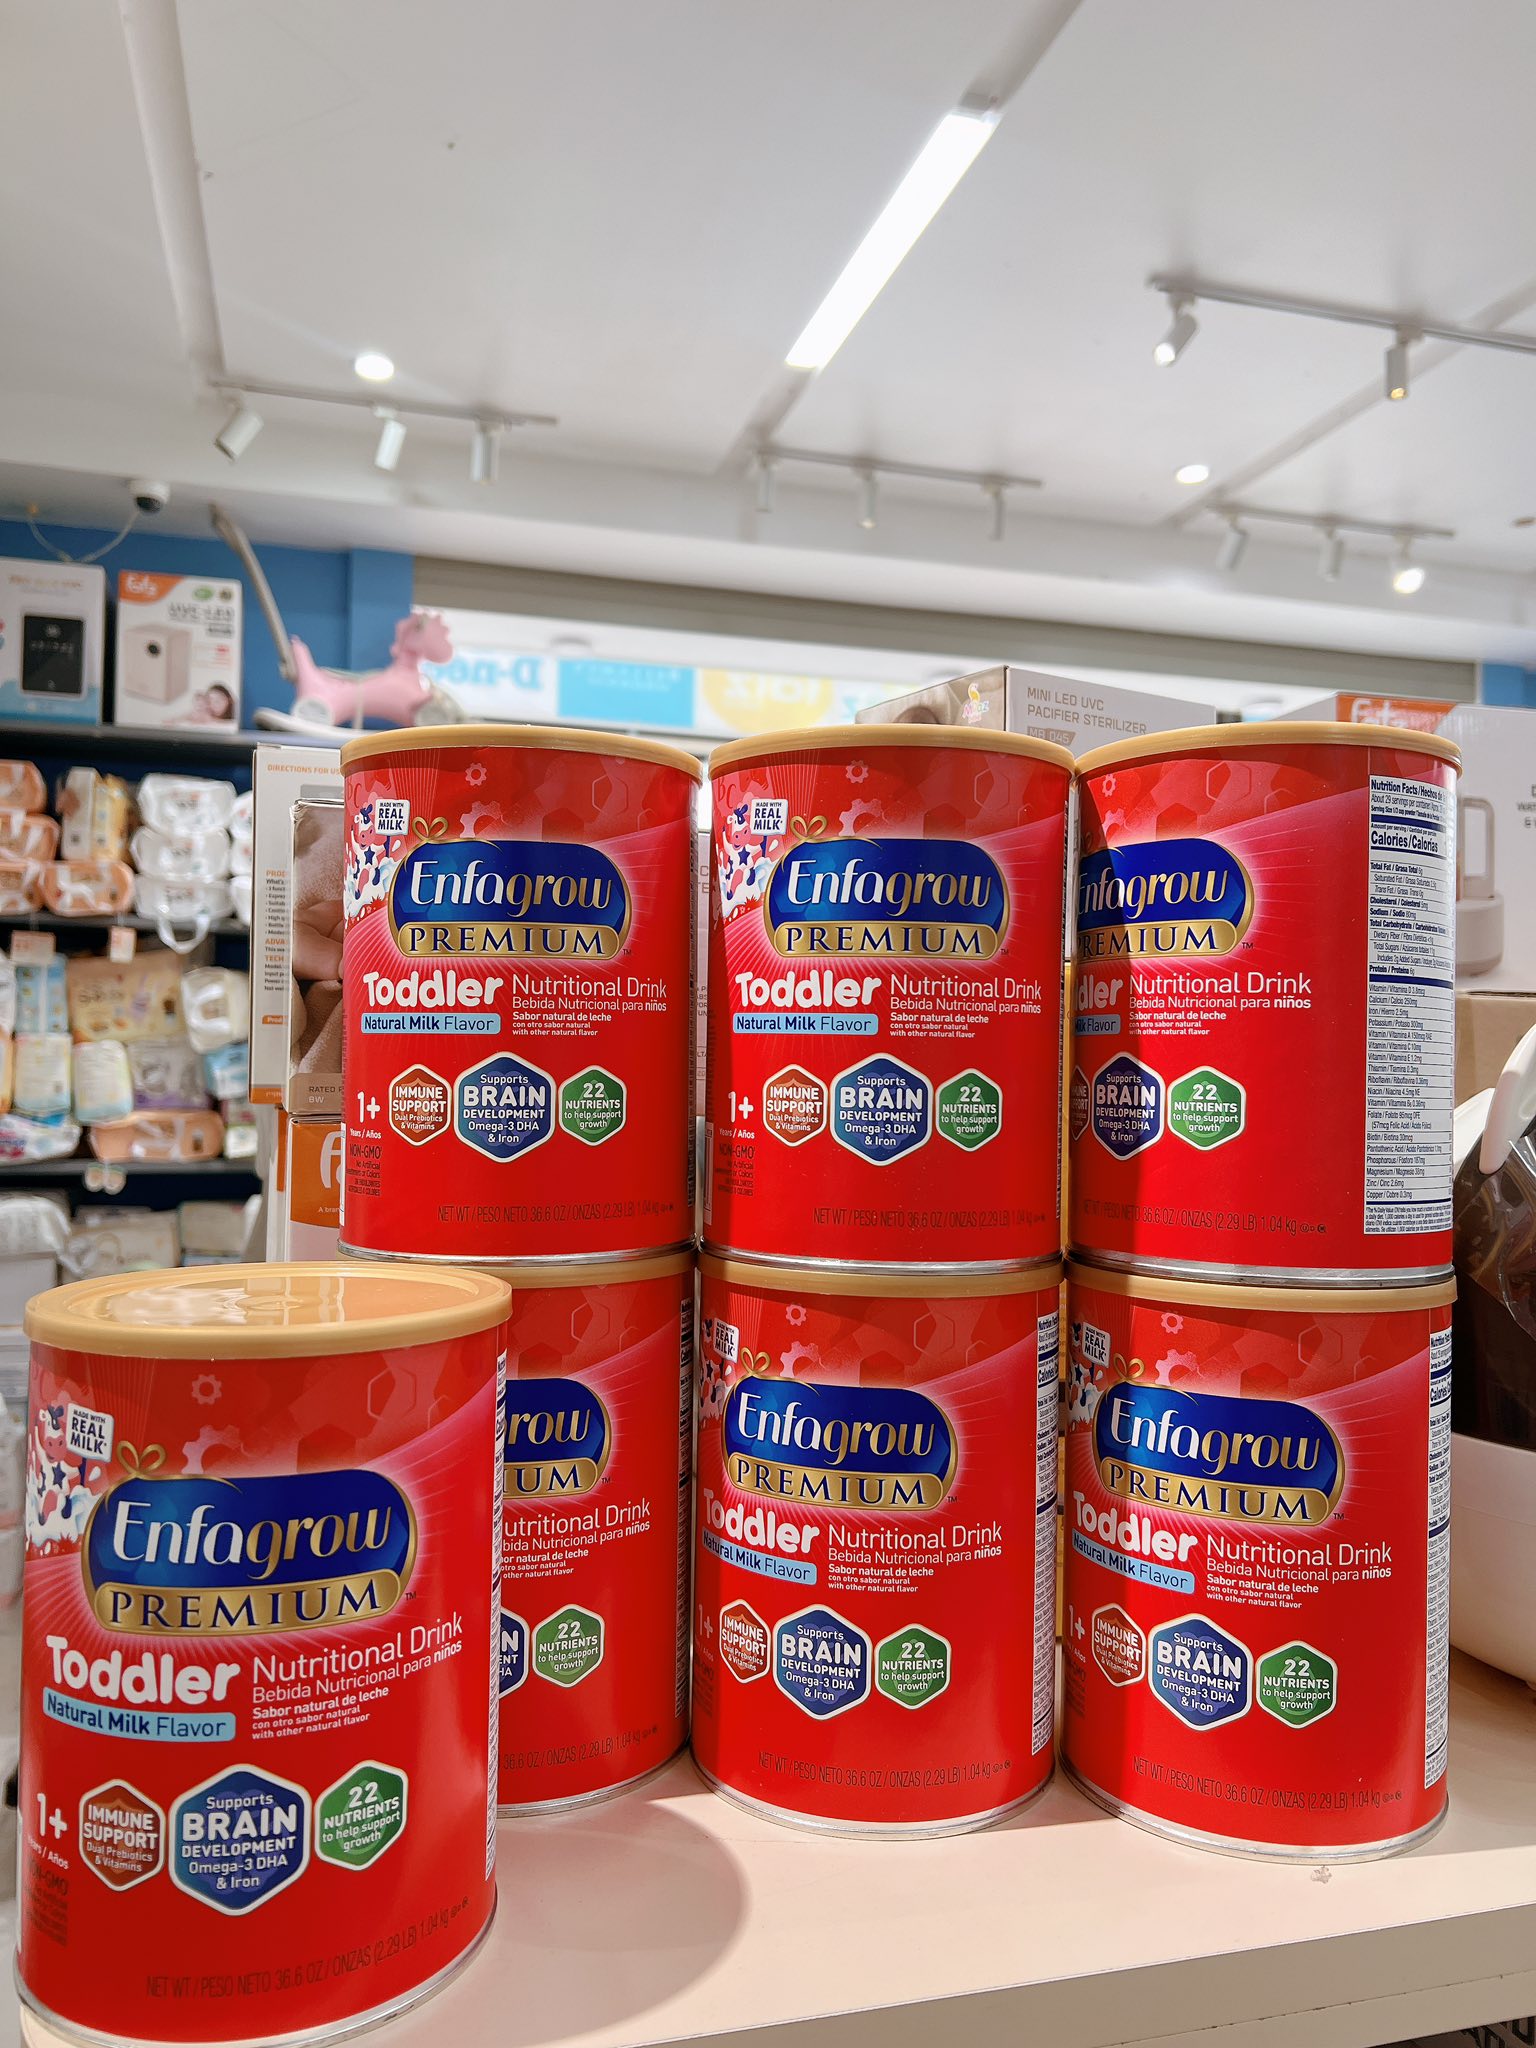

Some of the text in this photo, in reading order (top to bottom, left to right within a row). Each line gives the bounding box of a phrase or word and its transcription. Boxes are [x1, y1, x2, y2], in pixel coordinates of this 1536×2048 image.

[1027, 687, 1104, 711] MINI LED UVC
[1027, 704, 1147, 735] PACIFIER STERILIZER
[267, 764, 312, 773] DIRECTIONS
[1371, 779, 1400, 792] Nutrition
[378, 808, 404, 820] REAL
[1371, 862, 1392, 871] Total Fat
[411, 860, 611, 918] Enfagrow
[788, 859, 991, 916] Enfagrow
[1370, 908, 1388, 917] Sodium
[409, 927, 605, 954] PREMIUM
[786, 926, 984, 955] PREMIUM
[1370, 965, 1386, 973] Protein
[363, 970, 503, 1008] Toddler
[512, 974, 667, 998] Nutritional Drink
[735, 970, 882, 1008] Toddler
[890, 974, 1041, 1000] Nutritional Drink
[1130, 972, 1311, 994] Nutritional Drink
[512, 997, 667, 1013] Bebida Nutricional para niños
[1130, 996, 1311, 1011] Bebida Nutricional para niños
[365, 1017, 494, 1031] Natural Milk Flavor
[737, 1017, 872, 1032] Natural Milk Flavor
[890, 1012, 989, 1024] Sabor natural de leche
[480, 1074, 528, 1084] Supports
[583, 1082, 605, 1098] 22
[1106, 1074, 1141, 1084] Supports
[395, 1086, 443, 1099] IMMUNE
[463, 1085, 546, 1107] BRAIN
[770, 1086, 819, 1100] IMMUNE
[840, 1087, 923, 1110] BRAIN
[959, 1086, 981, 1102] 22
[1096, 1085, 1156, 1107] BRAIN
[1192, 1084, 1217, 1100] 22
[392, 1100, 446, 1113] SUPPORT
[463, 1109, 545, 1119] DEVELOPMENT
[565, 1098, 621, 1110] NUTRIENTS
[767, 1100, 822, 1114] SUPPORT
[942, 1103, 997, 1114] NUTRIENTS
[1096, 1108, 1155, 1119] DEVELOPMENT
[1174, 1102, 1237, 1113] NUTRIENTS
[839, 1110, 922, 1122] DEVELOPMENT
[845, 1123, 916, 1134] Omega-3 DHA
[1188, 1123, 1220, 1133] growth
[1366, 1179, 1377, 1187] Zinc
[1143, 1207, 1297, 1236] 36.6 OZ ONZAS (2.29 LB) 1.04 kg
[71, 1418, 105, 1440] REAL
[738, 1391, 935, 1465] Enfagrow
[1110, 1397, 1320, 1475] Enfagrow
[736, 1458, 928, 1505] PREMIUM
[1109, 1464, 1312, 1521] PREMIUM
[505, 1498, 650, 1537] utritional Drink
[704, 1488, 820, 1554] Toddler
[1073, 1492, 1198, 1562] Toddler
[625, 1521, 650, 1537] niños
[829, 1521, 1002, 1550] Nutritional Drink
[113, 1501, 392, 1580] Enfagrow
[1207, 1536, 1392, 1566] Nutritional Drink
[702, 1531, 811, 1581] Natural Milk Flavor
[1073, 1537, 1188, 1589] Natural Milk Flavor
[109, 1578, 381, 1629] PREMIUM
[558, 1621, 580, 1639] 22
[724, 1615, 764, 1642] IMMUNE
[1097, 1618, 1138, 1648] IMMUNE
[253, 1612, 463, 1684] Nutritional Drink
[539, 1635, 598, 1653] NUTRIENTS
[721, 1629, 767, 1657] SUPPORT
[781, 1634, 862, 1666] BRAIN
[901, 1642, 925, 1658] 22
[1094, 1630, 1141, 1662] SUPPORT
[46, 1635, 241, 1705] Toddler
[781, 1658, 861, 1679] DEVELOPMENT
[882, 1659, 944, 1671] NUTRIENTS
[1157, 1641, 1242, 1679] BRAIN
[1284, 1659, 1310, 1677] 22
[1156, 1665, 1241, 1692] DEVELOPMENT
[1263, 1676, 1330, 1689] NUTRIENTS
[47, 1693, 226, 1738] Natural Milk Flavor
[206, 1792, 274, 1811] Supports
[348, 1782, 378, 1810] 22
[87, 1804, 154, 1832] IMMUNE
[182, 1804, 297, 1843] BRAIN
[324, 1796, 400, 1829] NUTRIENTS
[83, 1821, 158, 1850] SUPPORT
[322, 1811, 401, 1843] to help support
[181, 1836, 296, 1859] DEVELOPMENT
[343, 1830, 381, 1853] growth
[189, 1855, 288, 1876] Omega-3 DHA
[216, 1874, 260, 1890] & Iron
